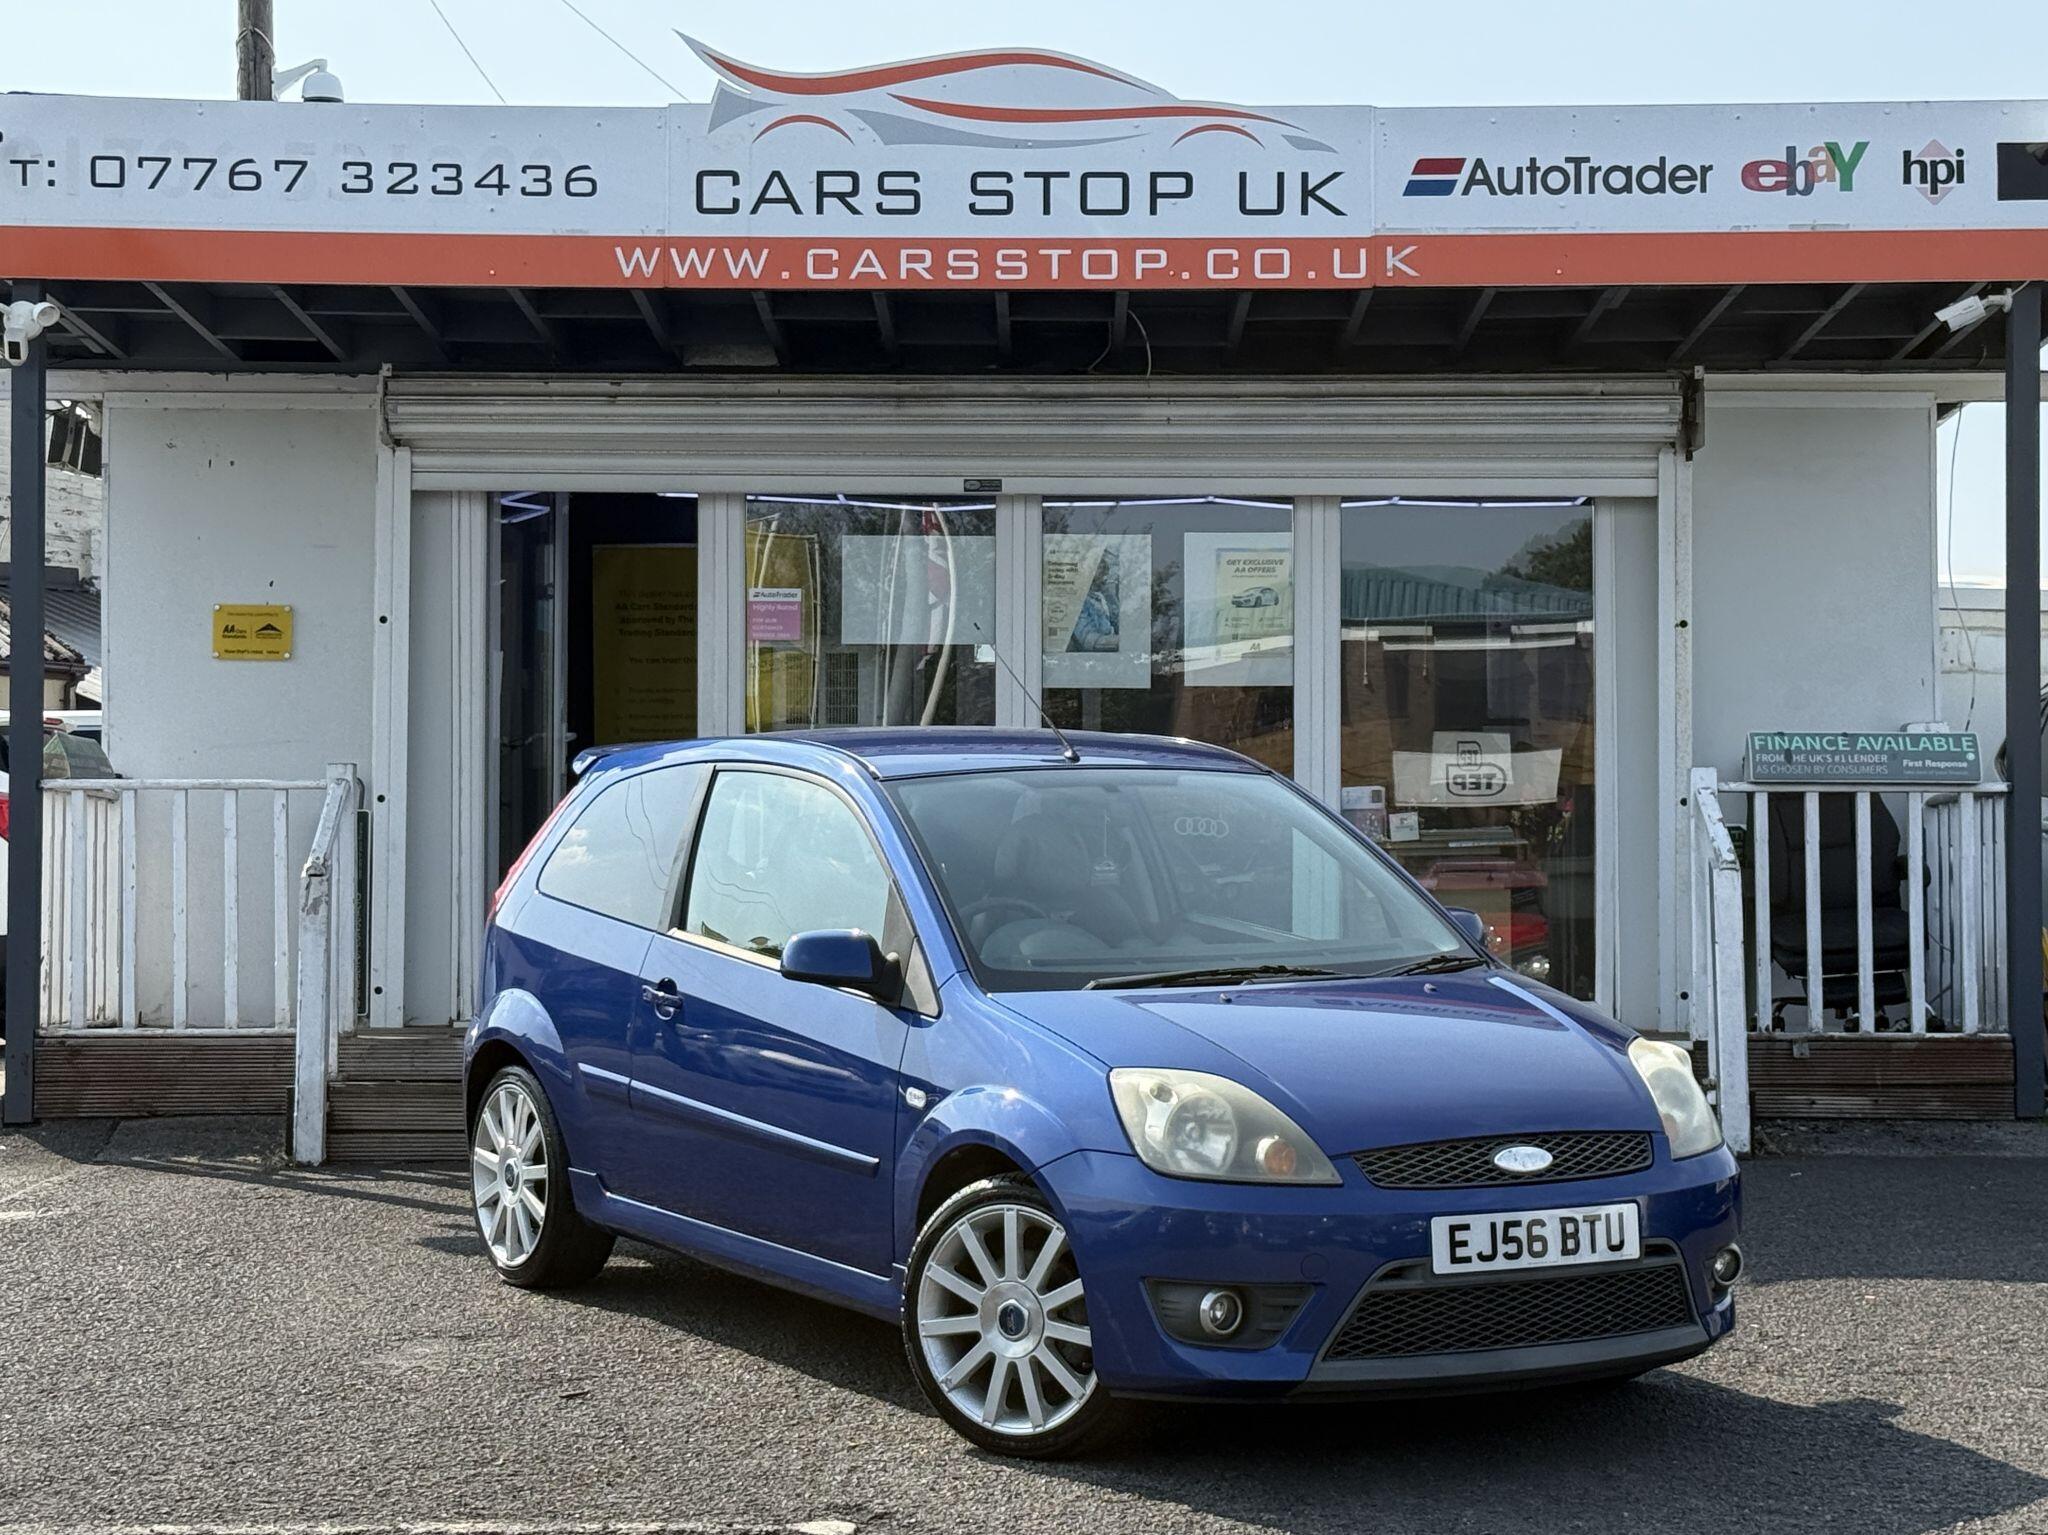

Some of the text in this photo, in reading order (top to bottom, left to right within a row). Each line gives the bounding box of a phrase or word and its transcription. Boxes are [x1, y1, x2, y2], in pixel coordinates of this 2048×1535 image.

[9, 155, 598, 198] T: 07767 323436
[1461, 156, 1714, 197] AutoTrader
[1902, 148, 1966, 196] hpi
[695, 169, 1348, 217] CARS STOP UK
[614, 245, 1420, 281] WWW.CARSSTOP.CO.UK
[760, 591, 798, 599] AutoTrader
[222, 624, 235, 633] AA
[1753, 735, 1976, 752] FINANCE AVAILABLE
[1755, 753, 1785, 763] FROM
[1786, 753, 1807, 763] HE
[1808, 753, 1833, 763] UK'S
[1848, 753, 1888, 763] LENDER
[1755, 764, 1769, 775] AS
[1770, 764, 1812, 775] CHOSEN
[1813, 764, 1827, 775] BY
[1827, 764, 1889, 775] CONSUMERS
[1902, 759, 1968, 769] First Response
[1448, 1211, 1626, 1265] EJ56 BTU
